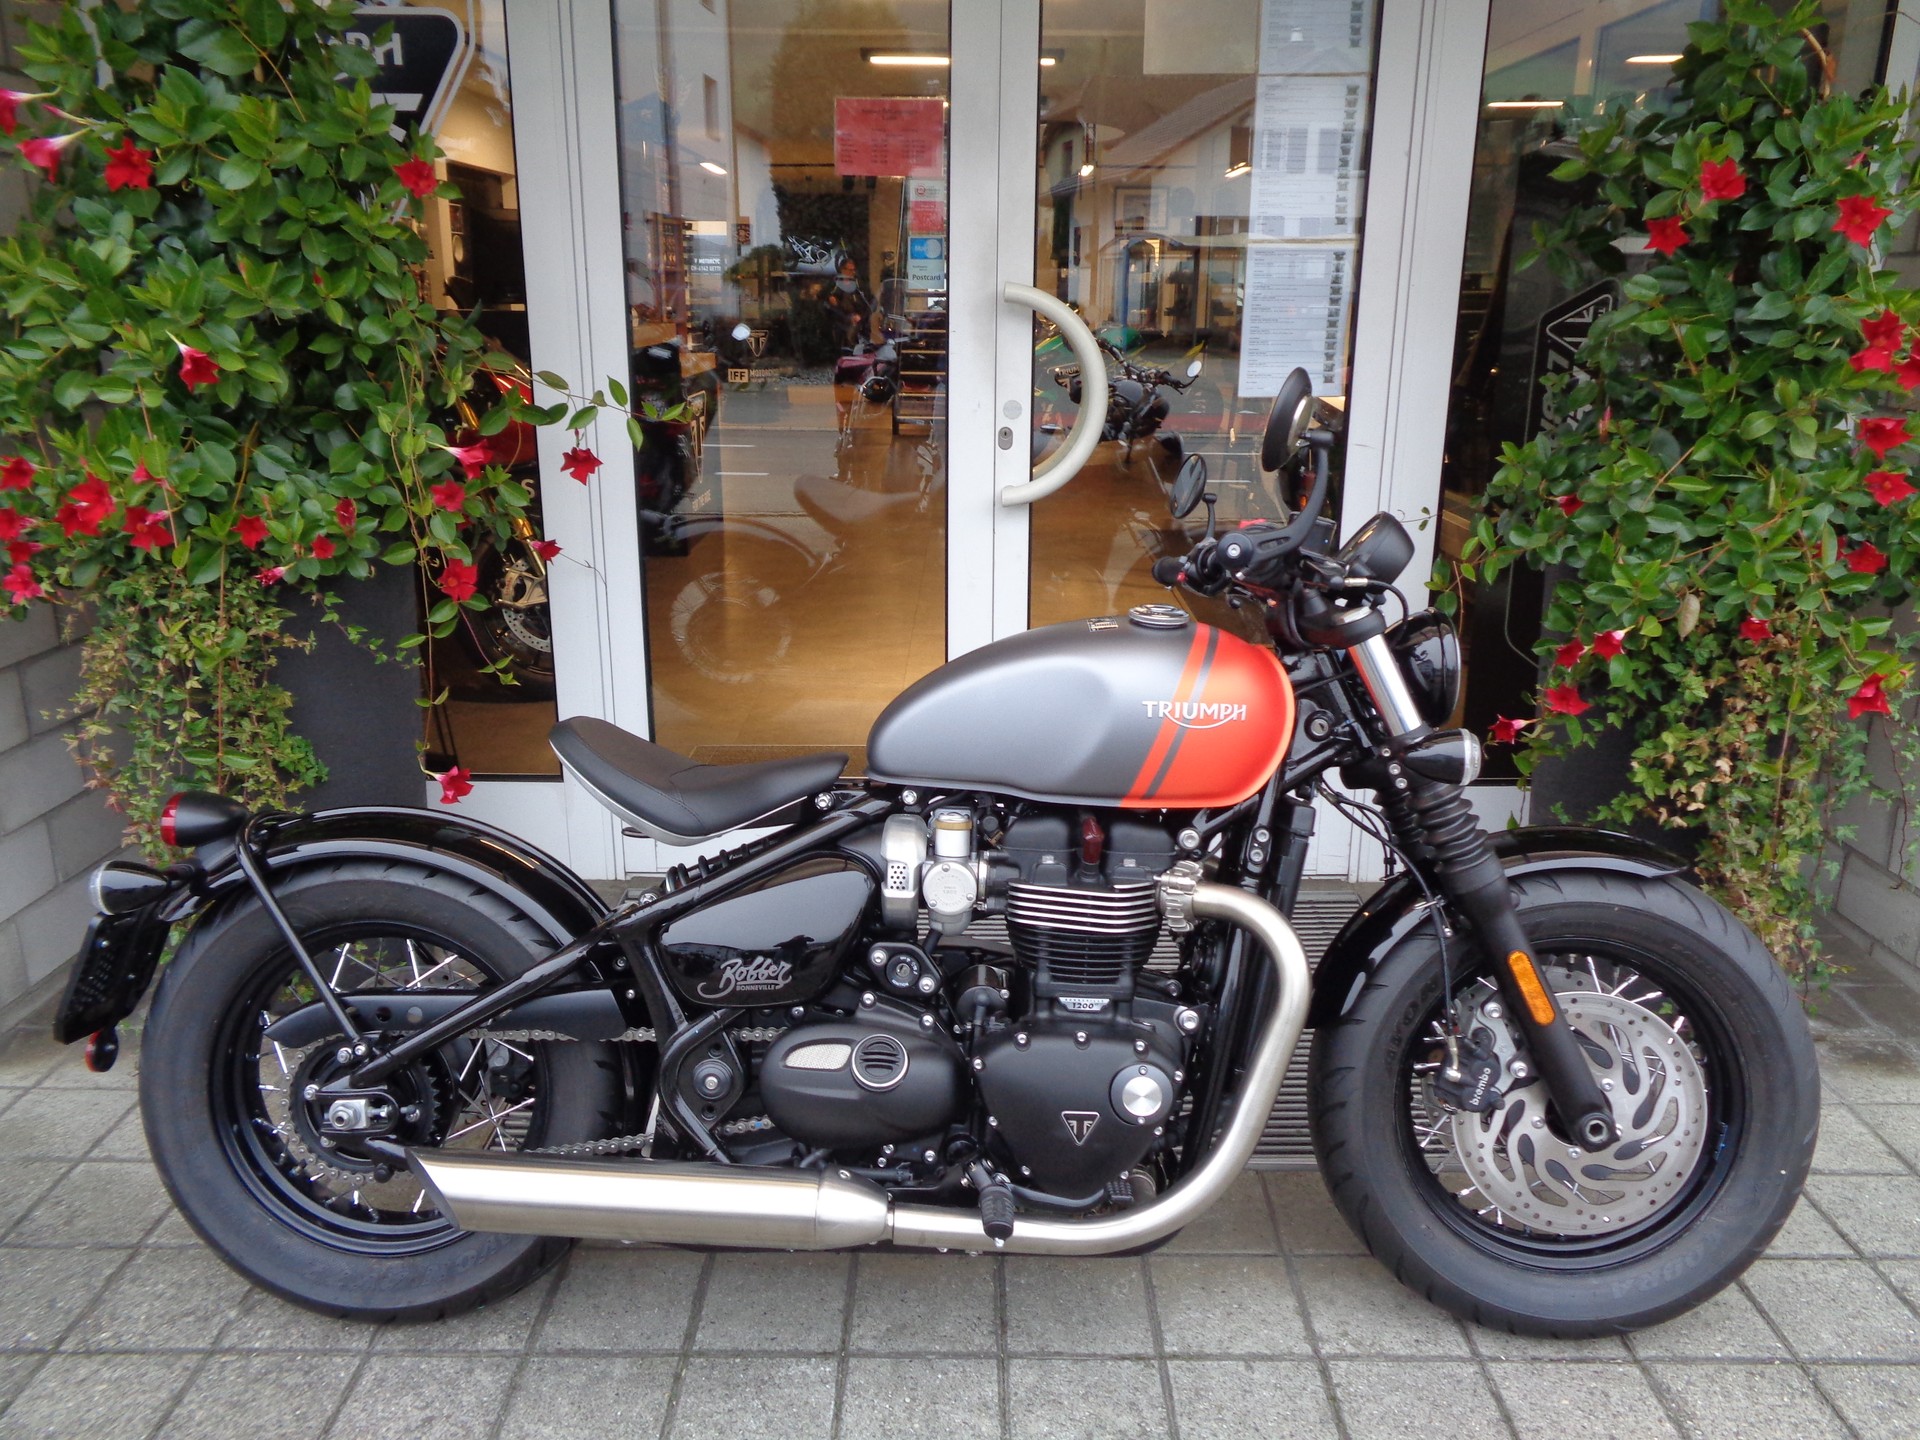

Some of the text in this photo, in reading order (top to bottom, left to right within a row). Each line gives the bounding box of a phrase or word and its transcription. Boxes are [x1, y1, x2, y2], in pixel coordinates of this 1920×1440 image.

[1142, 700, 1247, 728] TRIUMPH
[697, 956, 792, 998] Bobber
[1469, 1067, 1491, 1106] brembo
